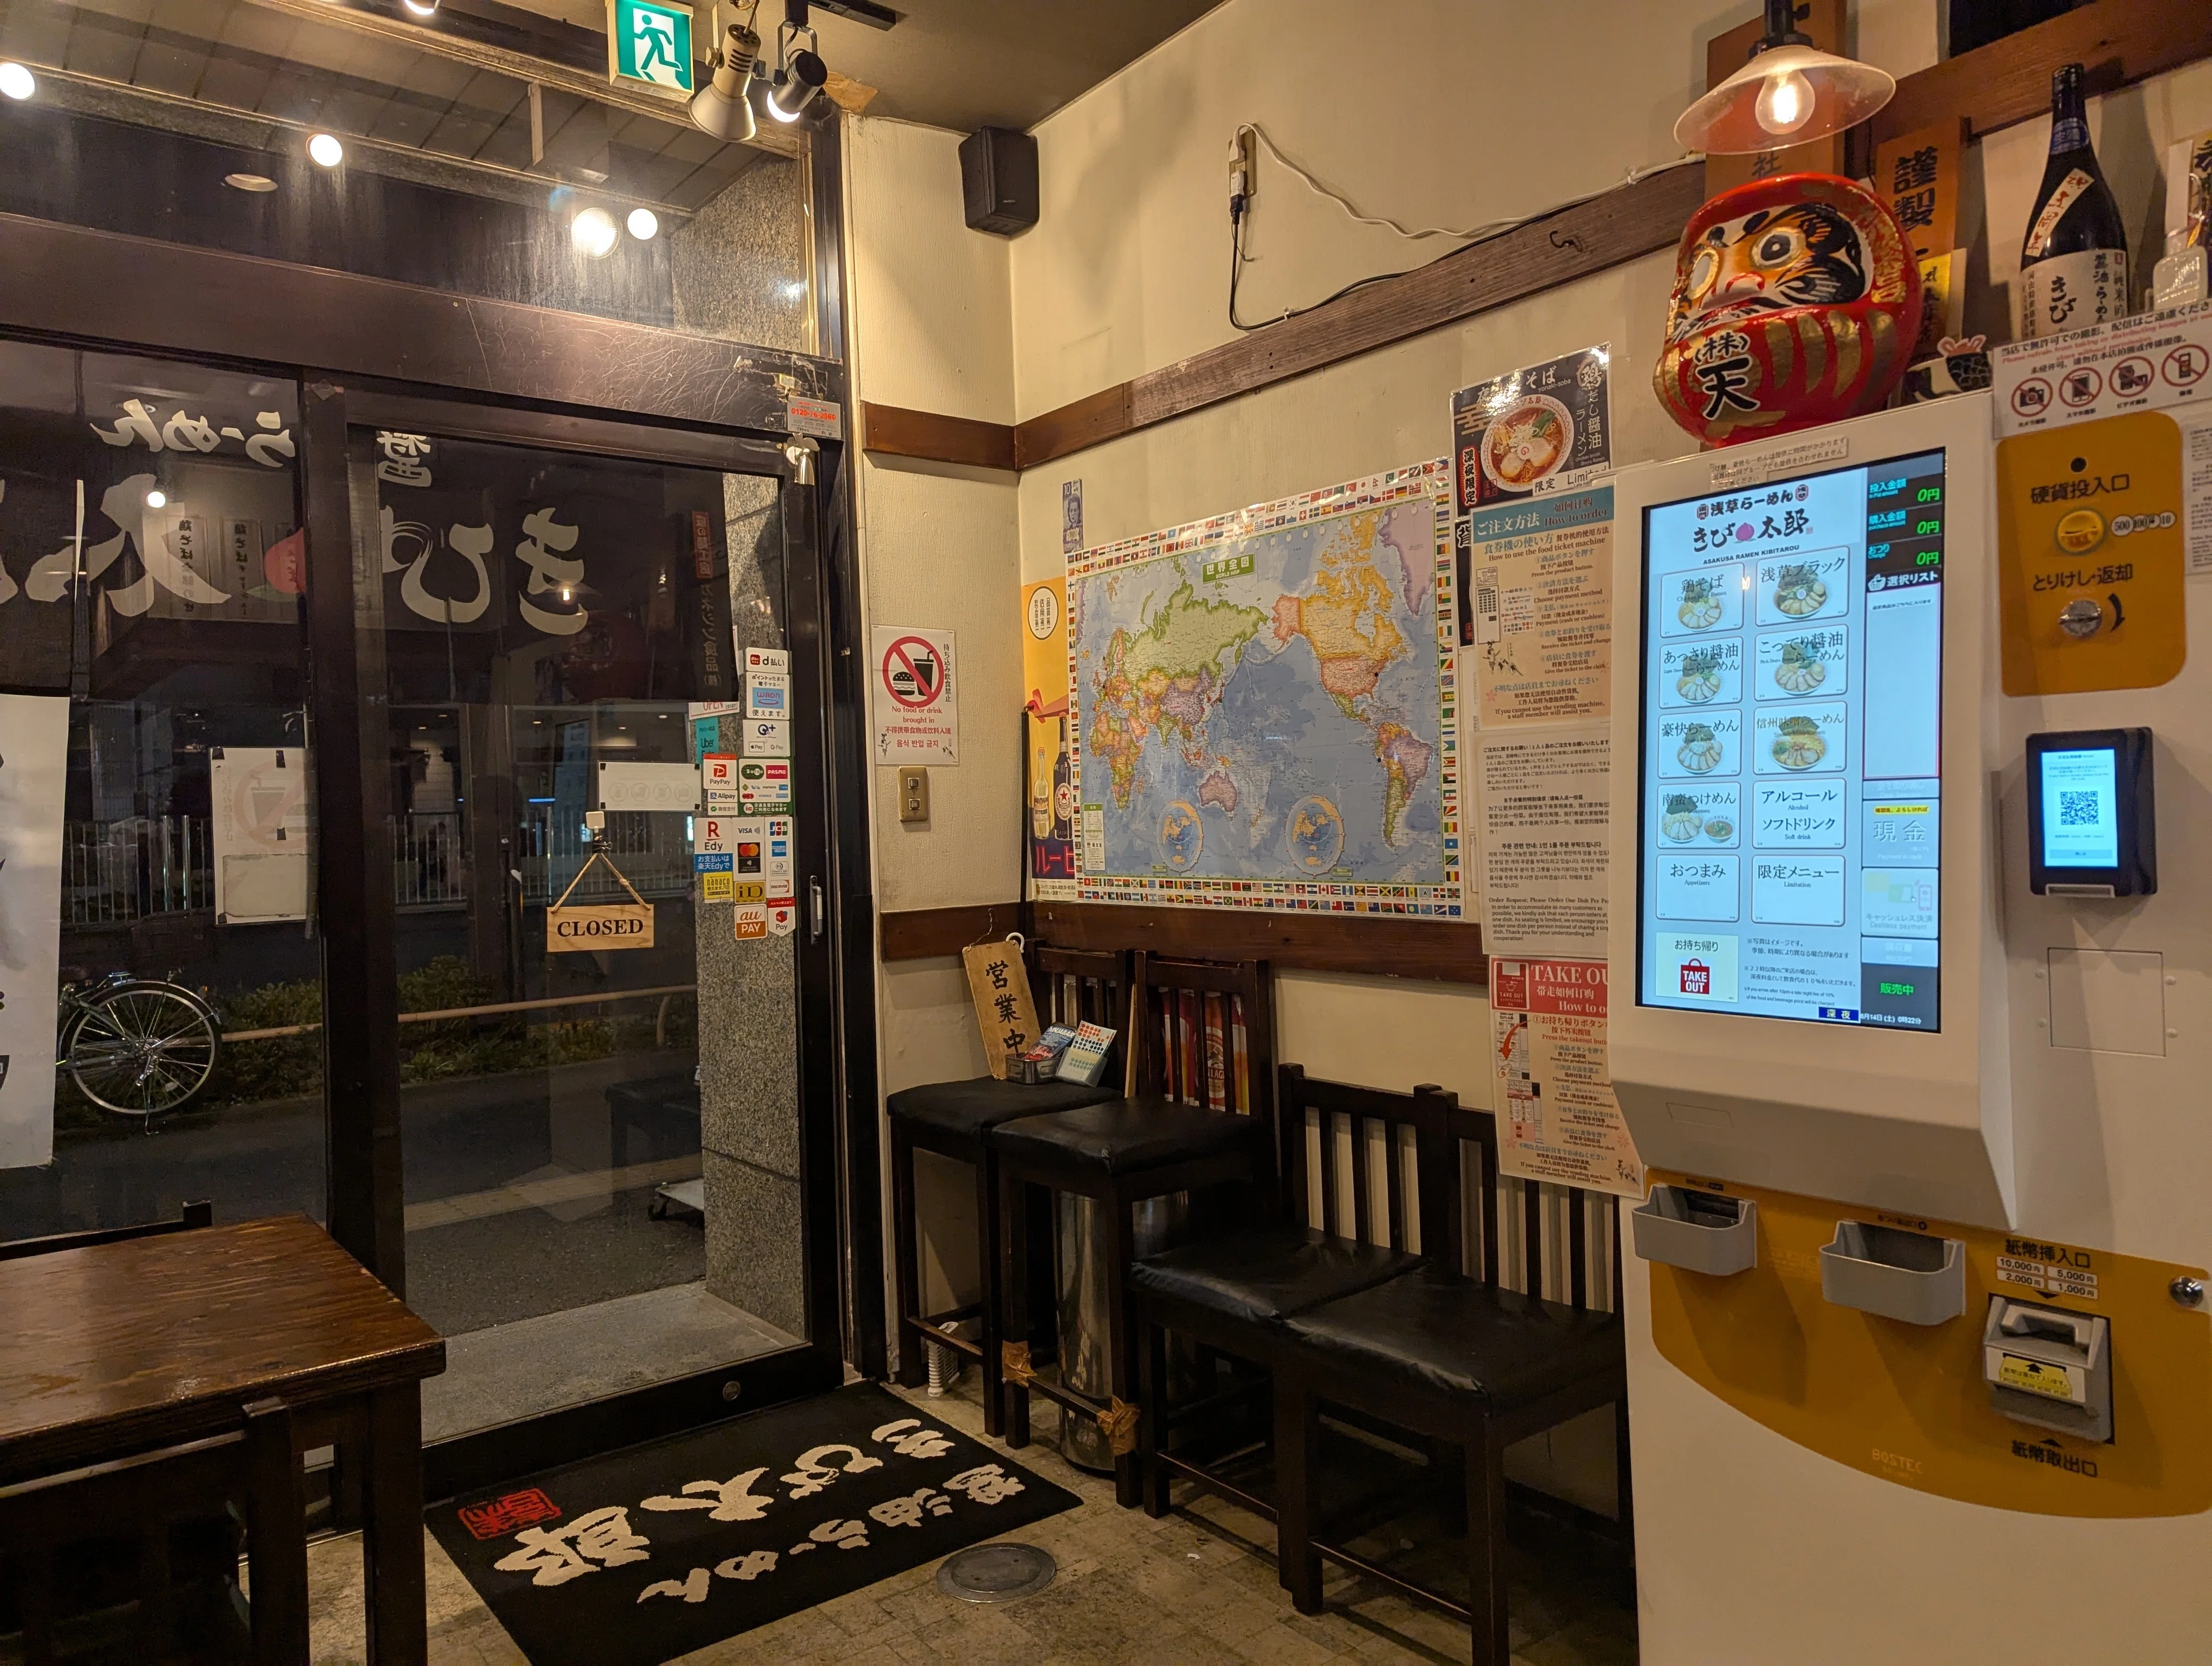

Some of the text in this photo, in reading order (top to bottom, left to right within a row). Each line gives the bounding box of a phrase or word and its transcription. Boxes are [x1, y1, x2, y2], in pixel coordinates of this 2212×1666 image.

[1538, 379, 1571, 393] yonaki-soba
[1696, 358, 1760, 420] 天
[1576, 408, 1586, 457] ラーメン
[1463, 448, 1477, 505] 深夜限定
[1064, 484, 1070, 495] 10
[1535, 478, 1555, 493] 限定
[2030, 474, 2130, 504] 硬貨投入口
[1917, 488, 1940, 502] 0円
[1711, 490, 1793, 517] 浅草らーめん
[1477, 512, 1539, 536] ご注文方法
[1545, 508, 1608, 526] How to order
[1917, 521, 1939, 534] 0円
[1489, 553, 1503, 561] How
[1526, 548, 1536, 556] the
[1538, 546, 1553, 554] food
[1554, 543, 1573, 551] ticket
[1576, 537, 1605, 547] machine
[1703, 545, 1799, 565] ASAKUSA RAMEN KIBITAROU
[1916, 552, 1939, 565] 0円
[1681, 557, 1846, 594] 鶏そば 浅草ブラック
[1887, 571, 1938, 587] 選択リスト
[1555, 593, 1579, 602] payment
[1580, 589, 1602, 597] method
[1664, 631, 1843, 664] あっさり醤油 こってり醤油
[763, 656, 785, 666] d払い
[943, 643, 951, 702] 持ち込み飲食禁止
[753, 709, 785, 717] 使えます。
[892, 706, 902, 714] No
[903, 716, 927, 726] brought
[1662, 714, 1844, 738] 豪快らーめん 信州味噌らーめん
[701, 738, 714, 748] Uber
[897, 739, 939, 748] 음식 반입 금지
[1662, 790, 1838, 806] 南蛮つけめん アルコール
[708, 821, 720, 837] R
[1762, 818, 1927, 842] ソフトドリンク 現金
[705, 841, 723, 851] Edy
[1670, 864, 1840, 879] おつまみ 限定メニュー
[707, 878, 730, 886] nanaco
[738, 885, 763, 898] iD
[740, 911, 762, 920] au
[557, 918, 644, 938] CLOSED
[741, 923, 761, 934] PAY
[1675, 940, 1719, 952] お持ち帰り
[1531, 965, 1581, 983] TAKE
[1683, 971, 1707, 983] TAKE
[1686, 982, 1705, 993] OUT
[1880, 982, 1914, 996] 販売中
[986, 959, 1026, 1053] 営業中
[1559, 1001, 1596, 1013] How to
[2005, 1239, 2091, 1268] 紙幣挿入口
[2001, 1257, 2094, 1284] 10,000円 5,000円
[2006, 1273, 2041, 1287] 2,000円
[2012, 1440, 2098, 1478] 紙幣取出口
